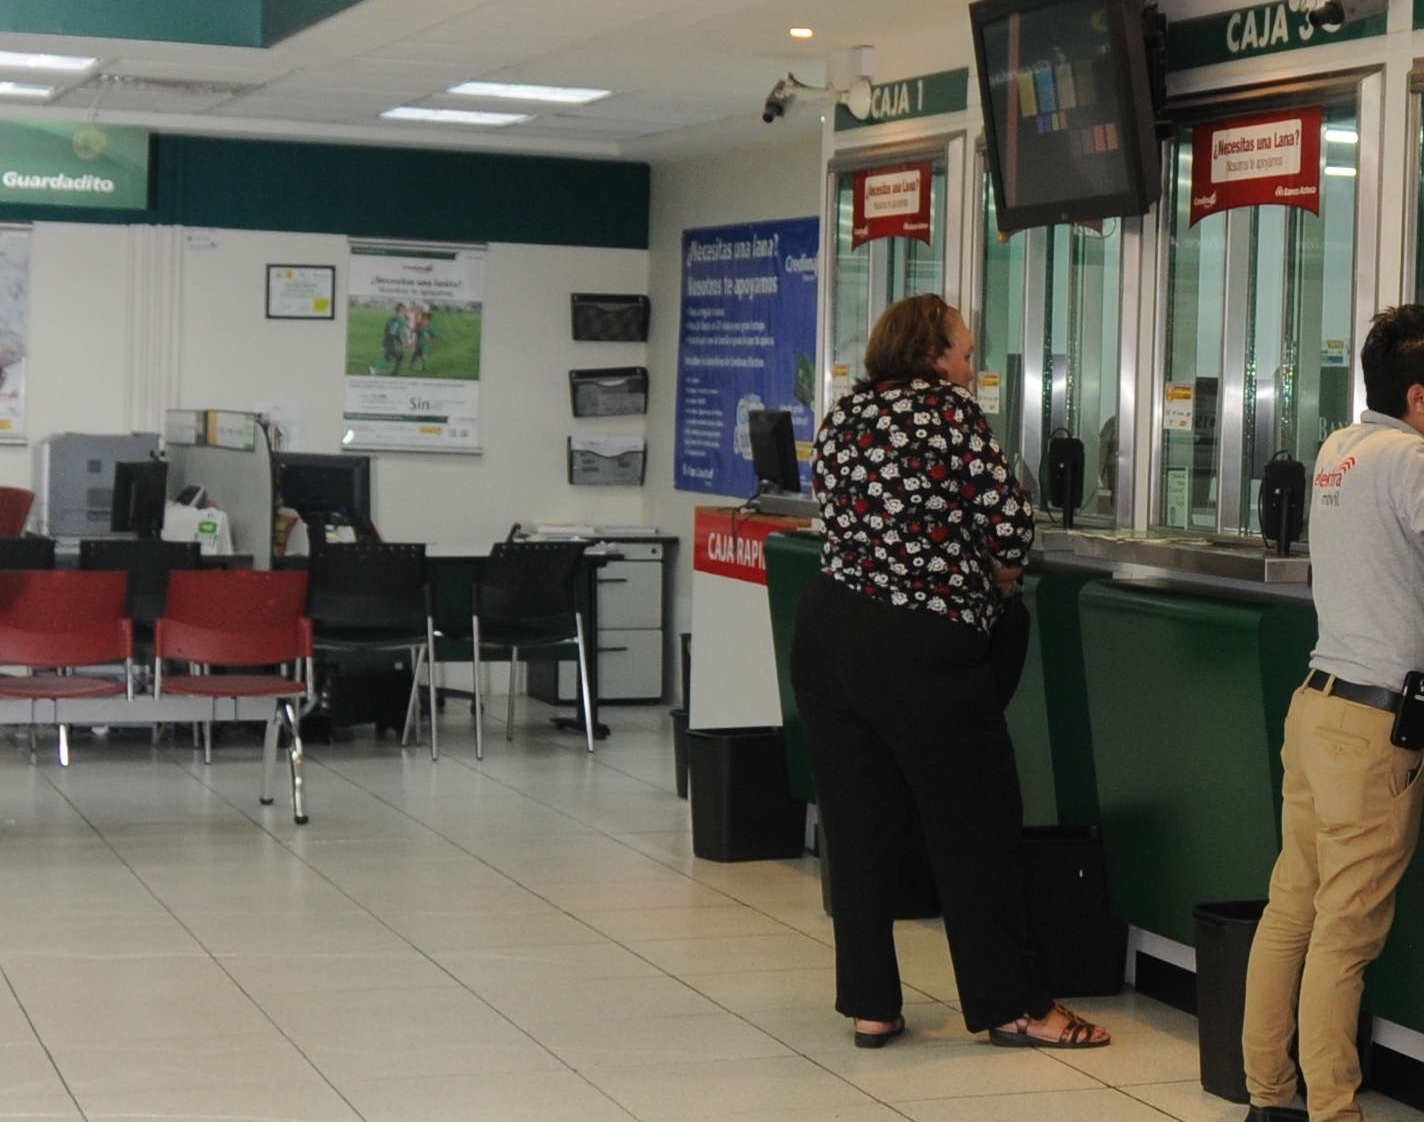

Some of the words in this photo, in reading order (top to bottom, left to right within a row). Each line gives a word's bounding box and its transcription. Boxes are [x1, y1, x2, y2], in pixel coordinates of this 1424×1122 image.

[1226, 4, 1289, 53] CAJA
[871, 82, 910, 119] CAJA
[917, 79, 923, 110] 1
[1213, 137, 1255, 160] ¿Necesitas
[1256, 136, 1272, 150] una
[1274, 129, 1300, 148] Lana?
[3, 171, 114, 193] Guardadito
[734, 241, 750, 258] una
[409, 397, 430, 410] Sin
[708, 532, 735, 564] CAJA
